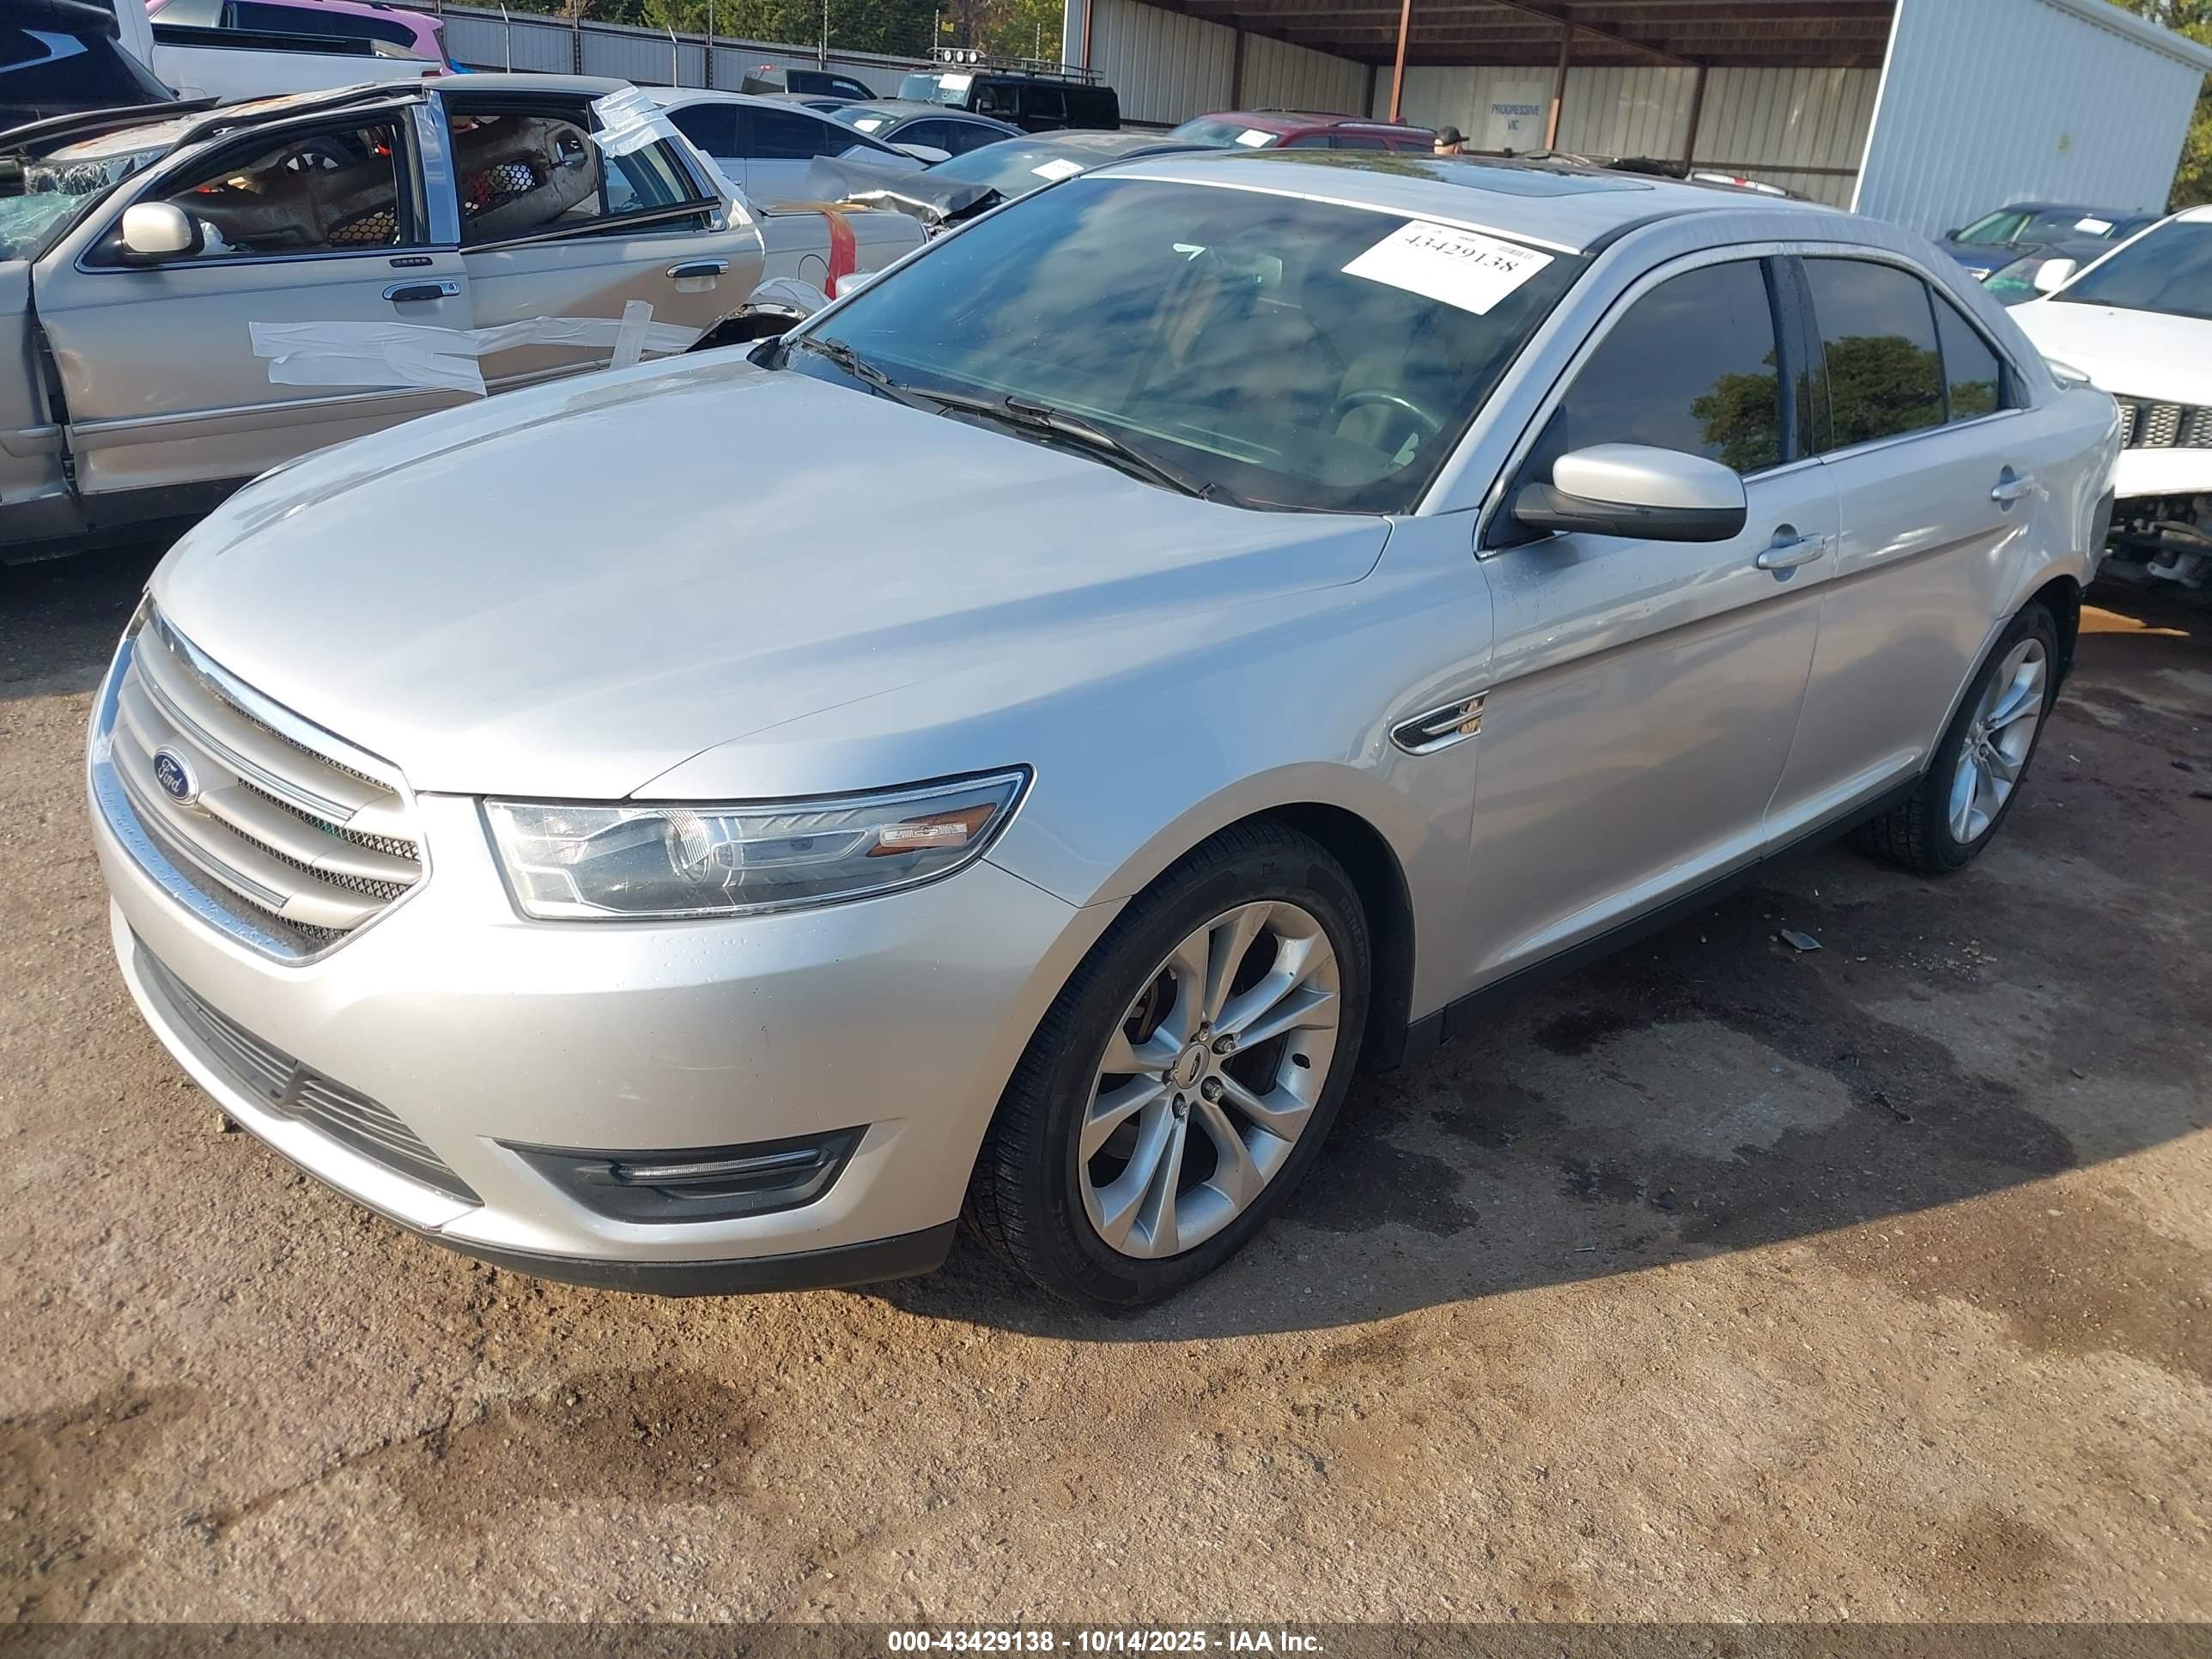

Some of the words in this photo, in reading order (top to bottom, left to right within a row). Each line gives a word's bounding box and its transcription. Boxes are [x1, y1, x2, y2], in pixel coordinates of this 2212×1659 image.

[1491, 104, 1540, 117] PROGRESSIVE
[1405, 234, 1519, 272] 43429138
[157, 758, 183, 793] Ford
